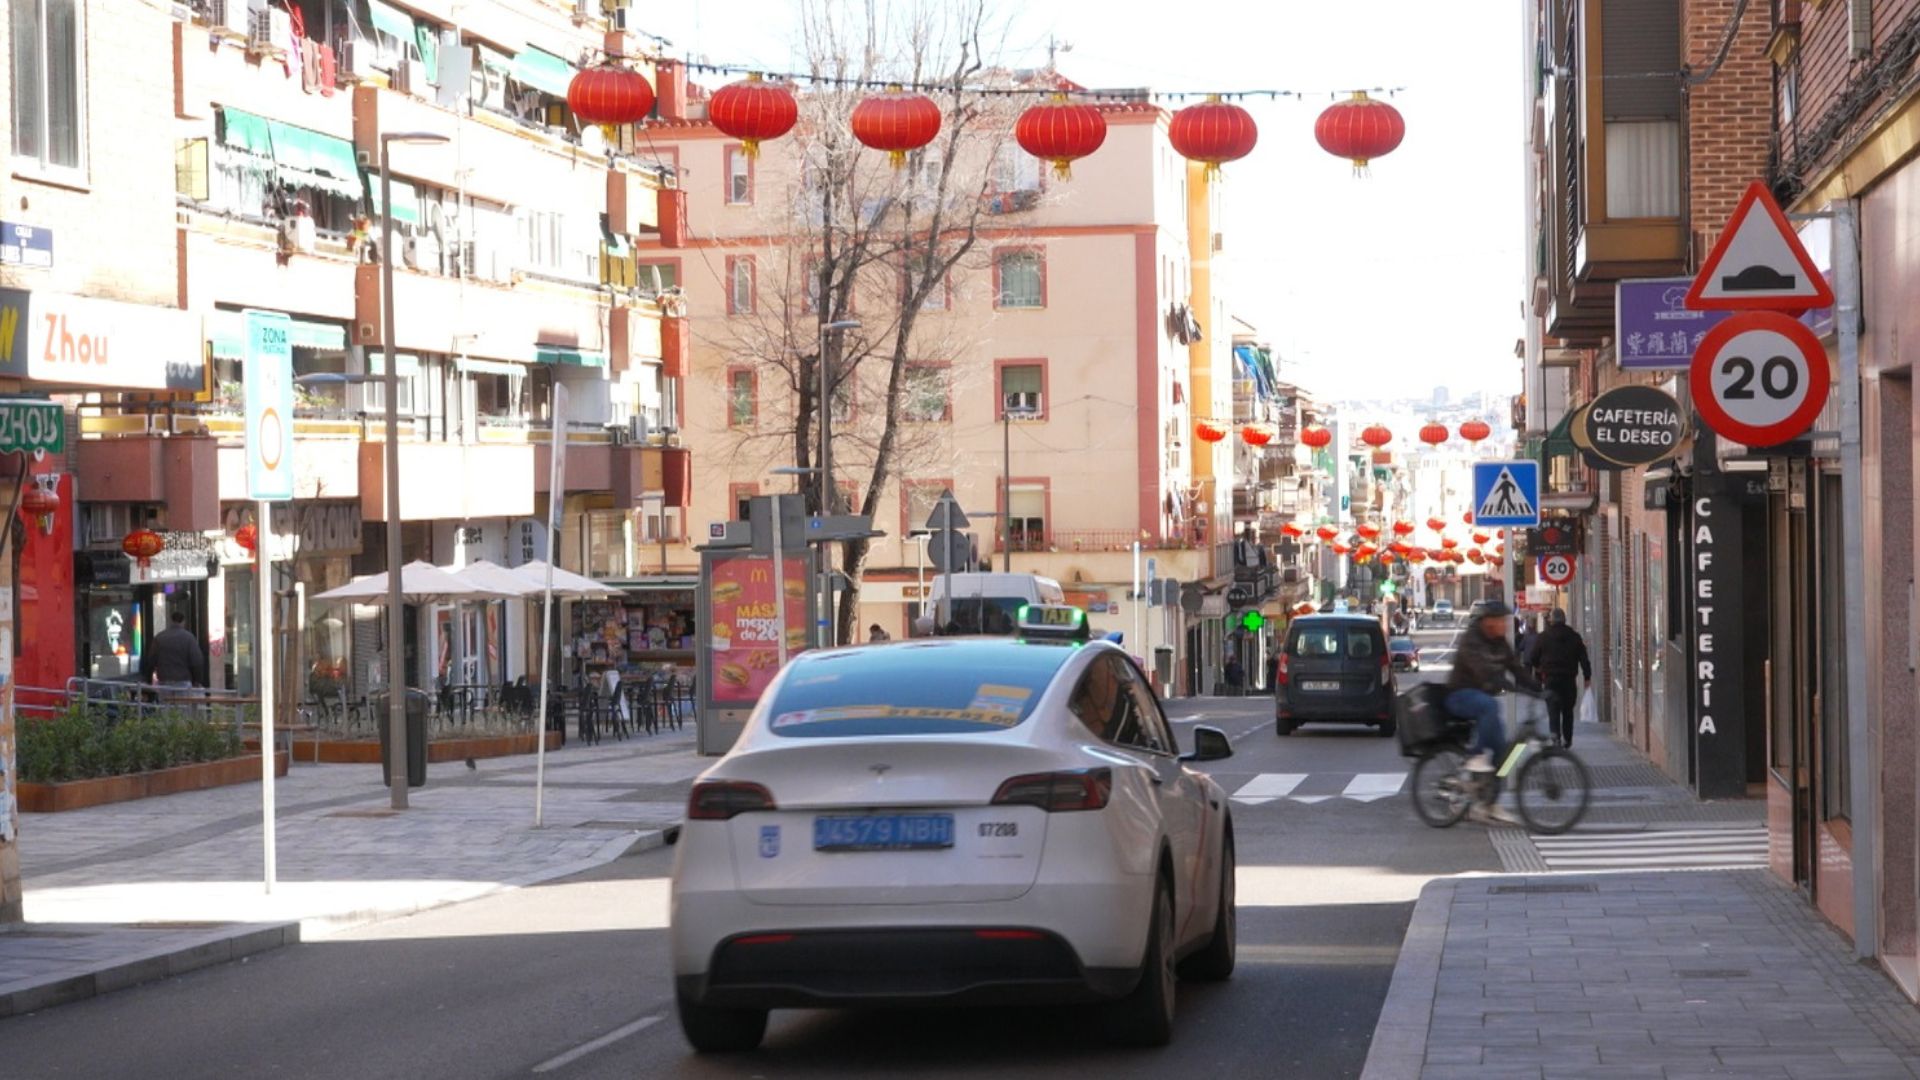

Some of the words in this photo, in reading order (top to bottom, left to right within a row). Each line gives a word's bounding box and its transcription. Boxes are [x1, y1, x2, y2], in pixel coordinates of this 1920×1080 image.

[44, 312, 108, 365] Zhou
[262, 327, 287, 343] ZONA
[1721, 355, 1798, 399] 20
[1593, 408, 1679, 425] CAFETERÍA
[1597, 427, 1616, 442] EL
[1620, 429, 1672, 445] DESEO
[1548, 563, 1567, 574] 20
[1695, 498, 1716, 734] CAFETERÍA
[830, 817, 891, 843] 4579
[901, 816, 949, 843] NBH
